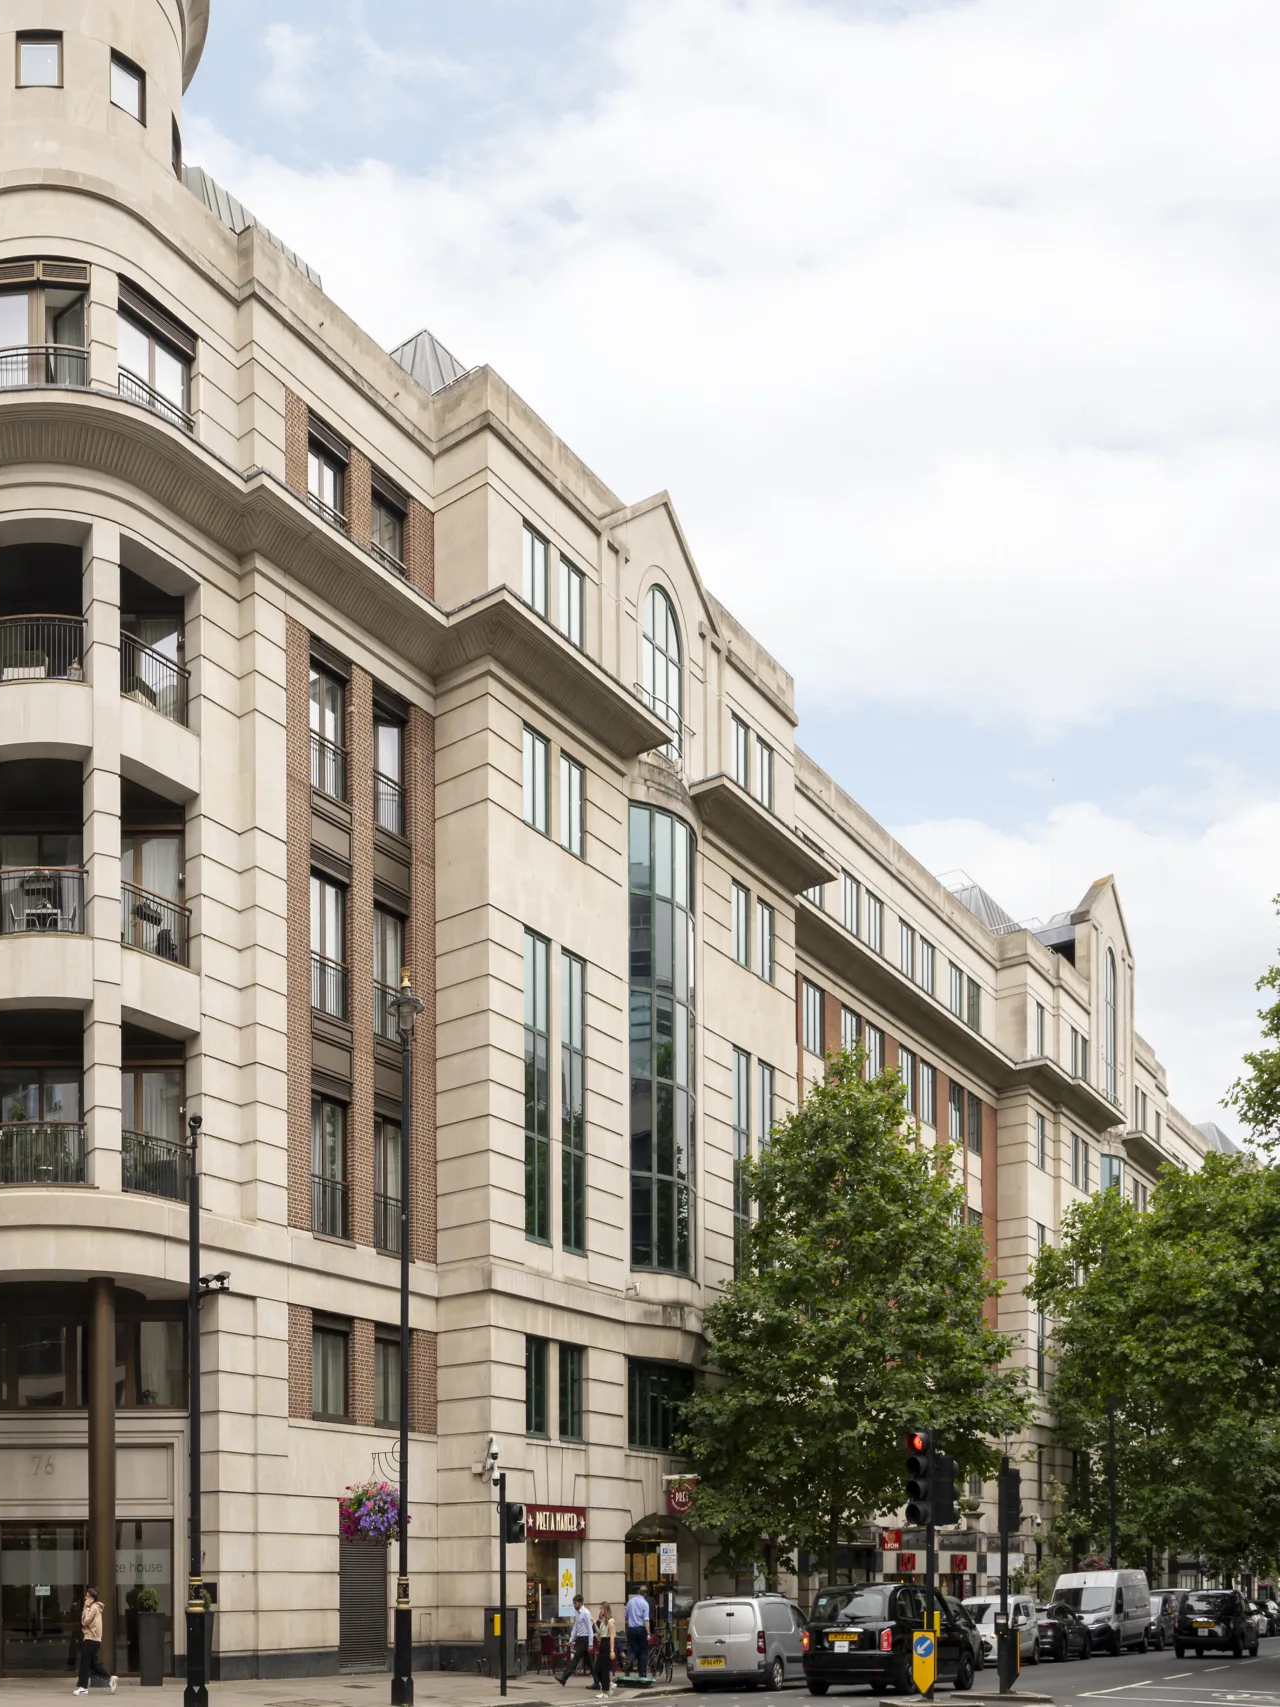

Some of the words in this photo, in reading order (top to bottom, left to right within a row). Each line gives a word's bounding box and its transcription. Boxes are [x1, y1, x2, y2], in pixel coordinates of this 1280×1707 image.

[30, 1454, 55, 1476] 76
[535, 1511, 550, 1531] PRET
[550, 1511, 556, 1531] A
[555, 1511, 578, 1532] MANGER
[130, 1562, 163, 1573] house
[899, 1552, 916, 1571] LEON
